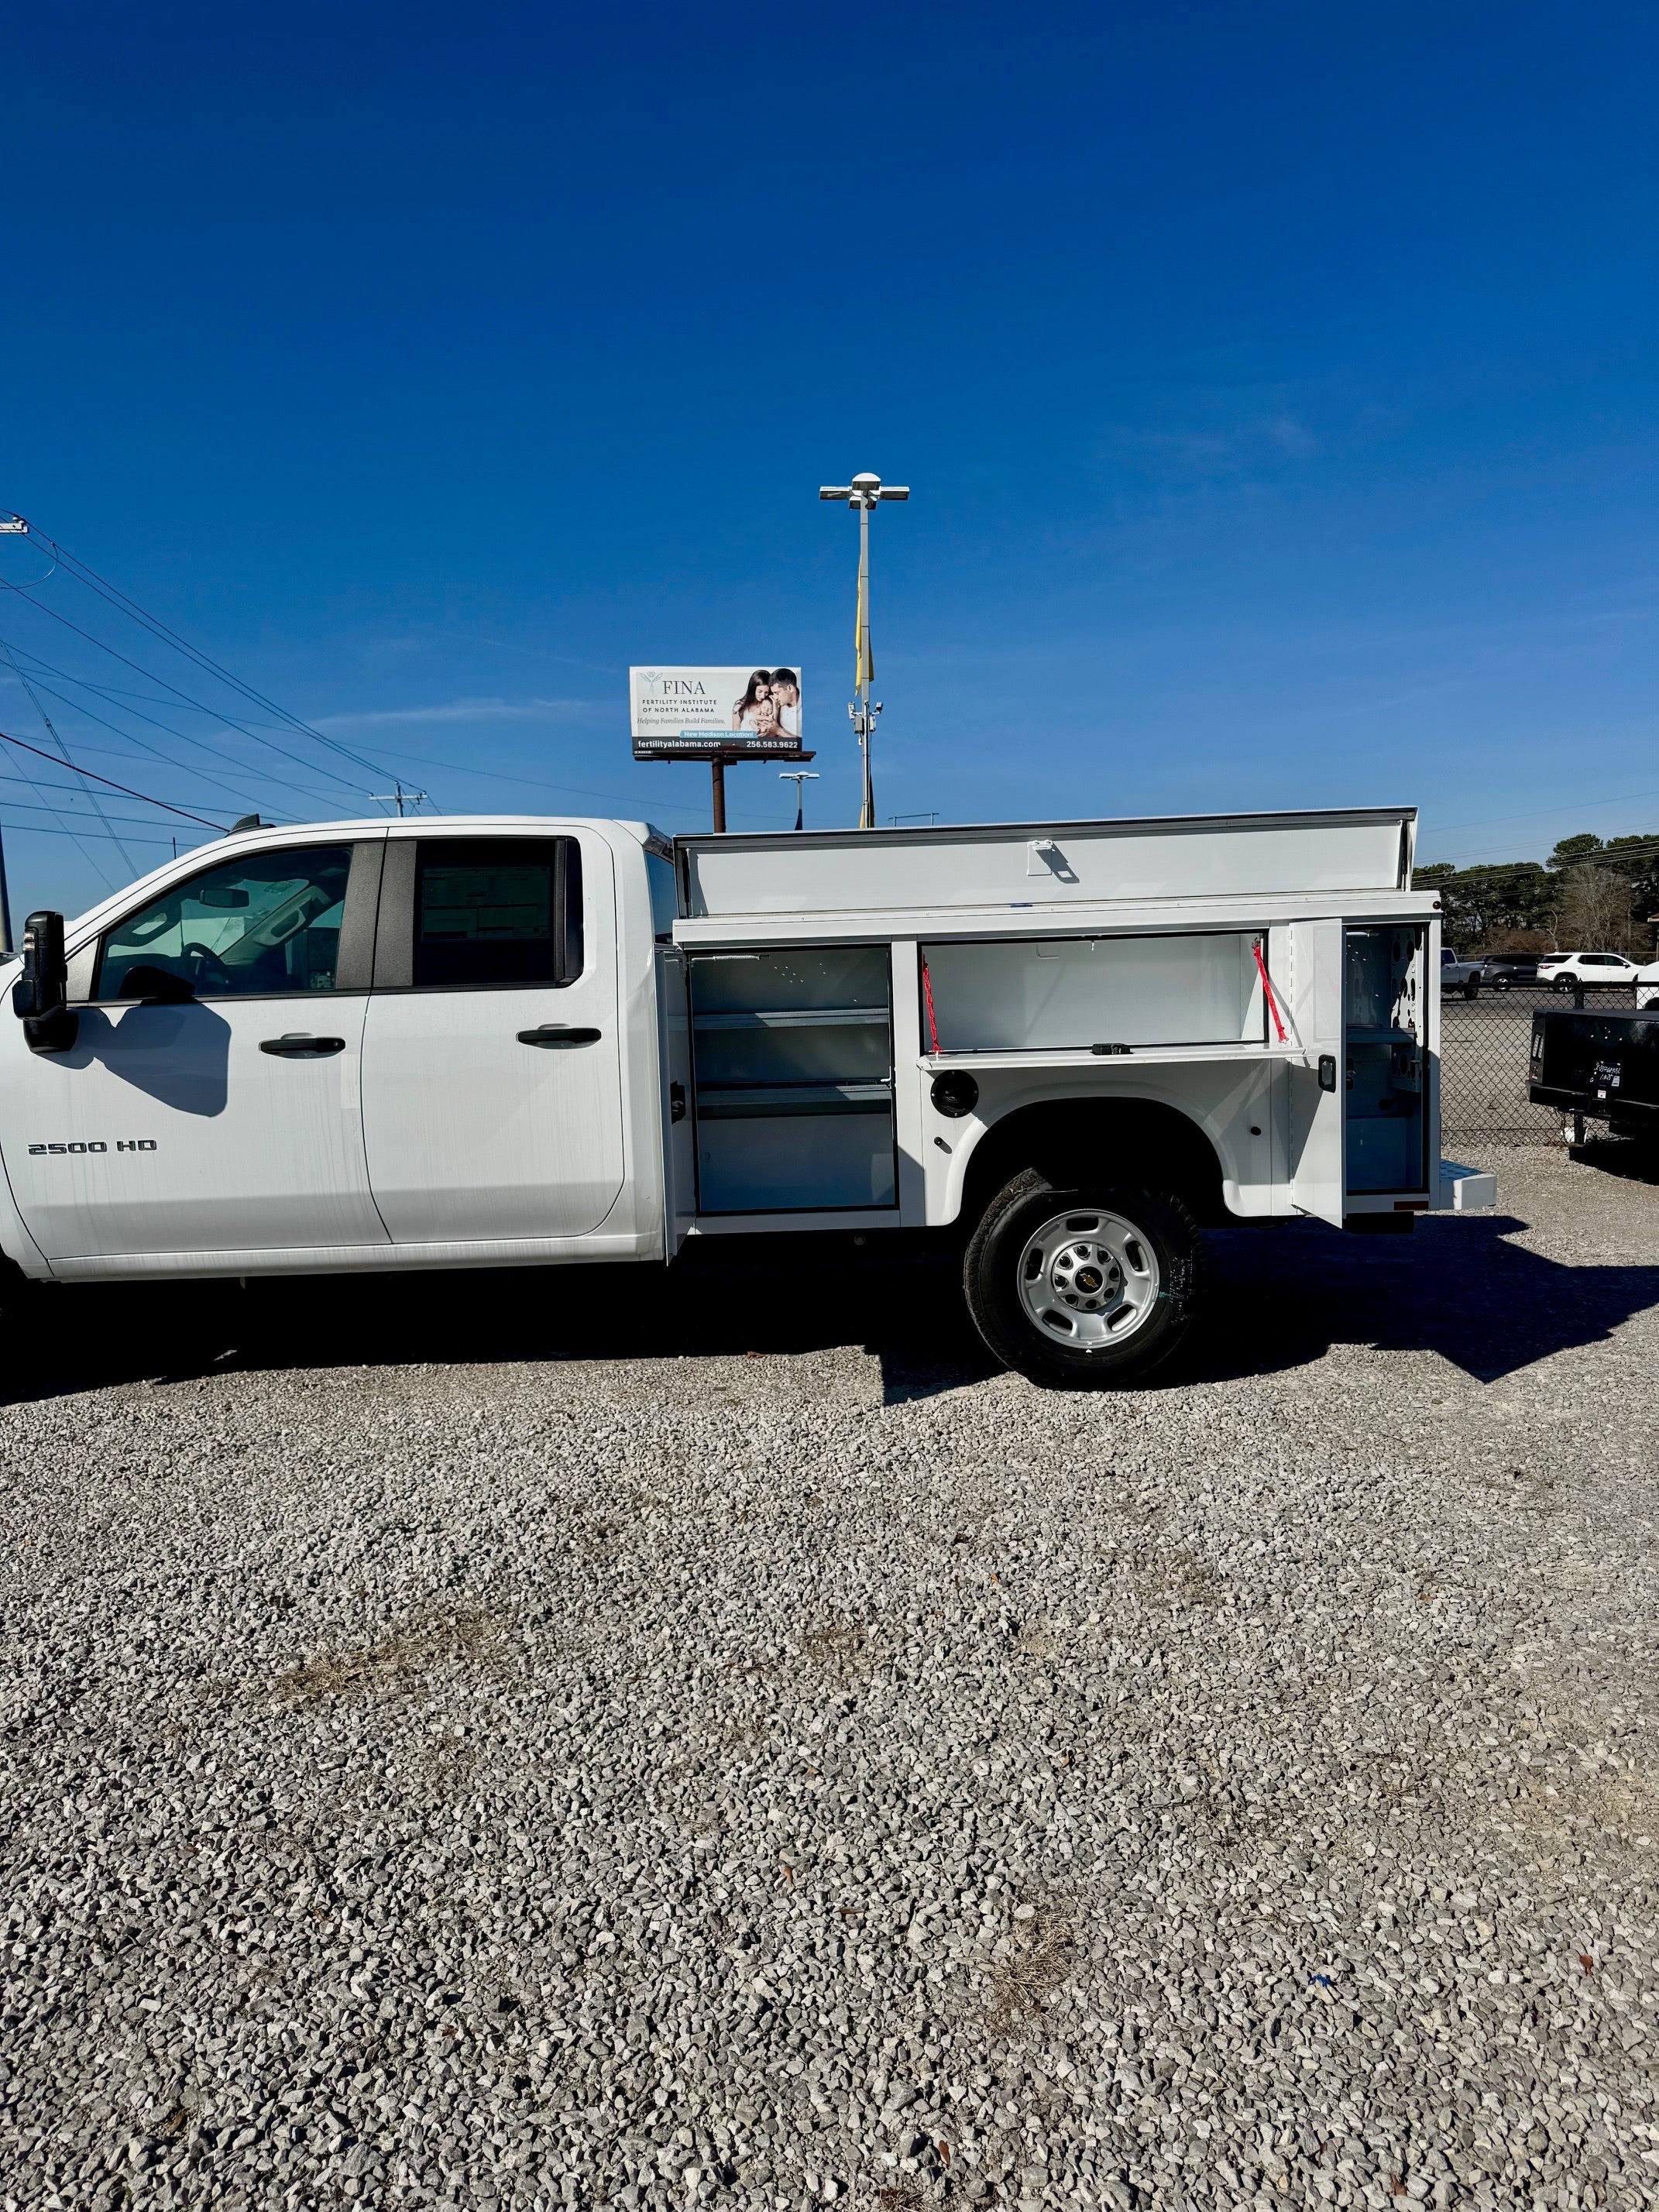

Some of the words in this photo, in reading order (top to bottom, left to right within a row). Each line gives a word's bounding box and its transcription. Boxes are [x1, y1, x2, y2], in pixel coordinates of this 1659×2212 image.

[662, 681, 706, 695] FINA
[637, 740, 721, 749] fertilityalabama.com
[28, 1141, 107, 1156] 2500
[116, 1139, 157, 1152] HD
